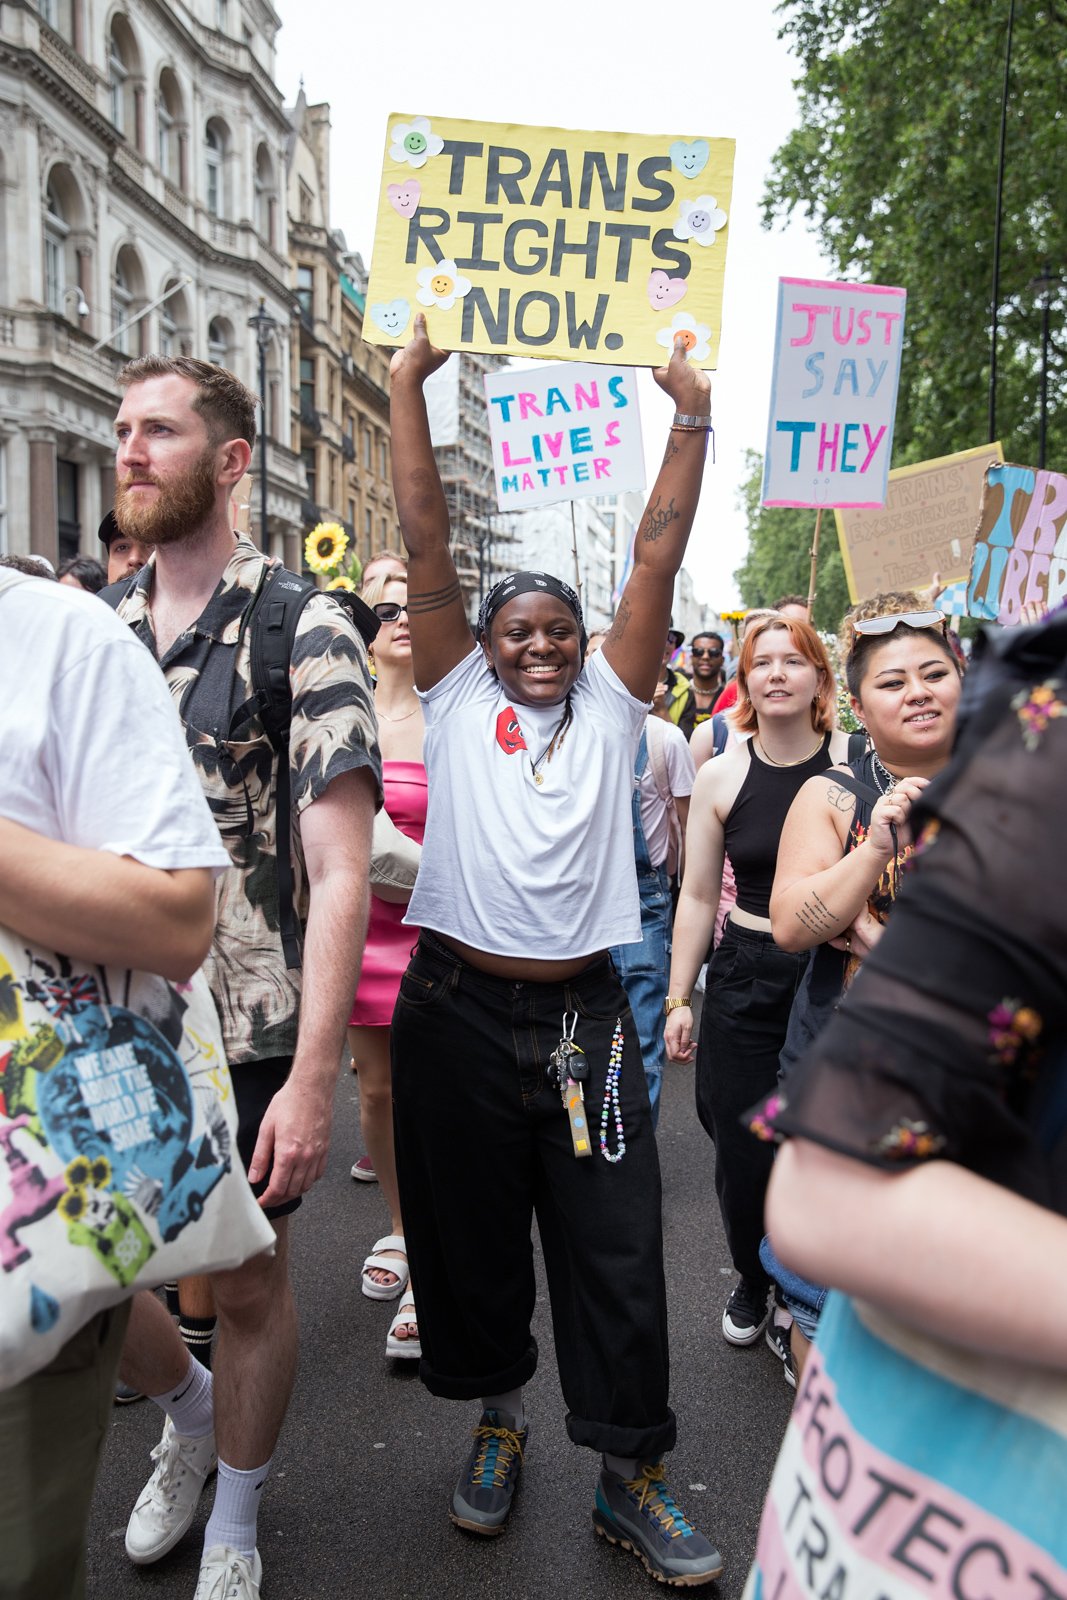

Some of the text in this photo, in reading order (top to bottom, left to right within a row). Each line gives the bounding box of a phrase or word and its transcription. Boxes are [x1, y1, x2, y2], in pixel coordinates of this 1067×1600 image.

[441, 140, 676, 212] TRANS
[405, 206, 692, 283] RIGHTS
[461, 286, 624, 350] NOW.
[790, 303, 902, 347] JUST
[491, 376, 629, 423] TRANS
[802, 352, 889, 399] SAY
[501, 421, 621, 468] LIVES
[776, 420, 888, 474] THEY
[501, 457, 612, 494] MATTER
[987, 465, 1067, 560] TR
